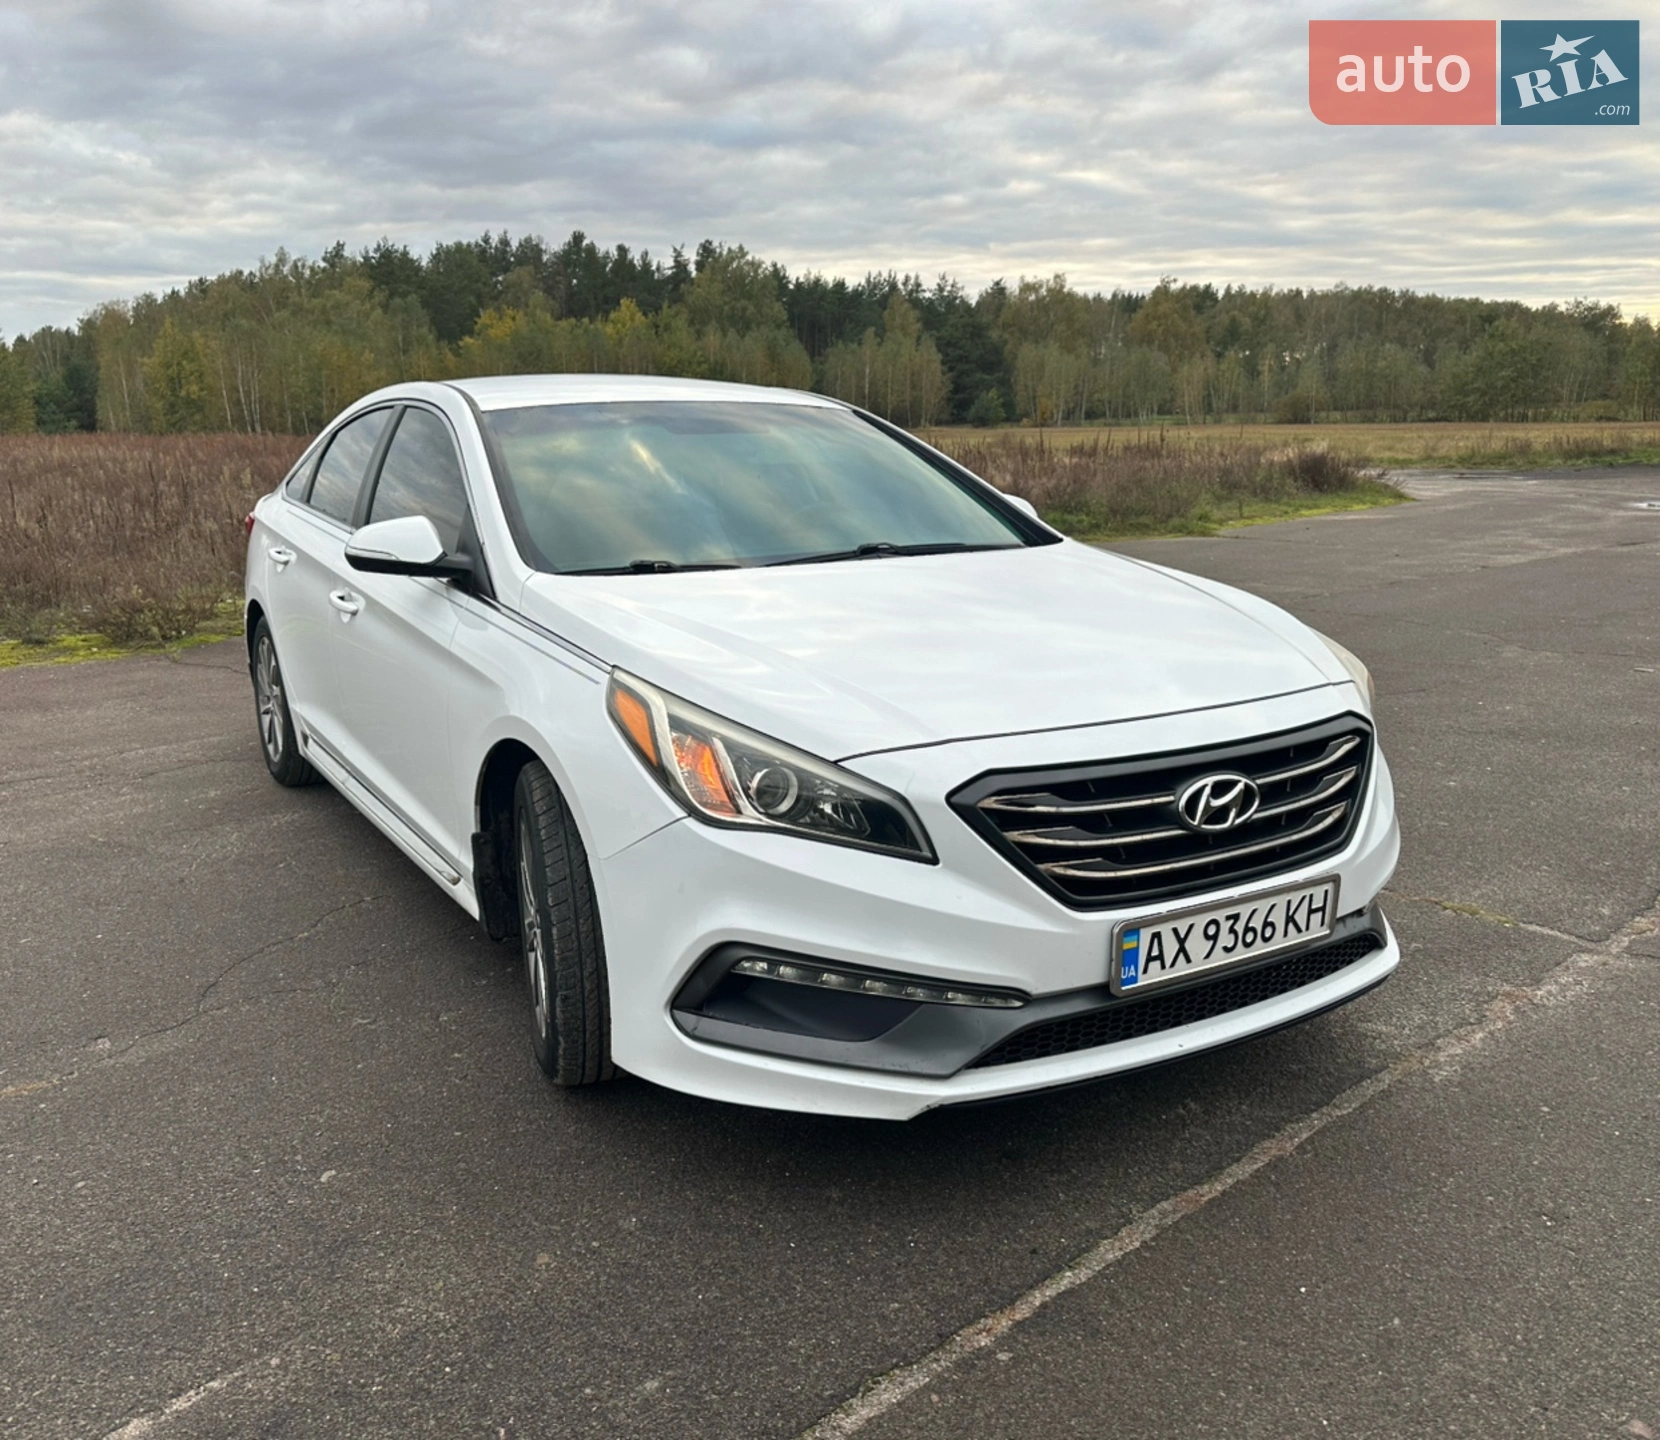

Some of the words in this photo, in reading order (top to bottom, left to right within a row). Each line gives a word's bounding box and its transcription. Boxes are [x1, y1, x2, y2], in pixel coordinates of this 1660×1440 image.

[1142, 922, 1195, 975] AX
[1203, 903, 1277, 960] 9366
[1283, 889, 1329, 938] KH
[1121, 965, 1136, 979] UA
